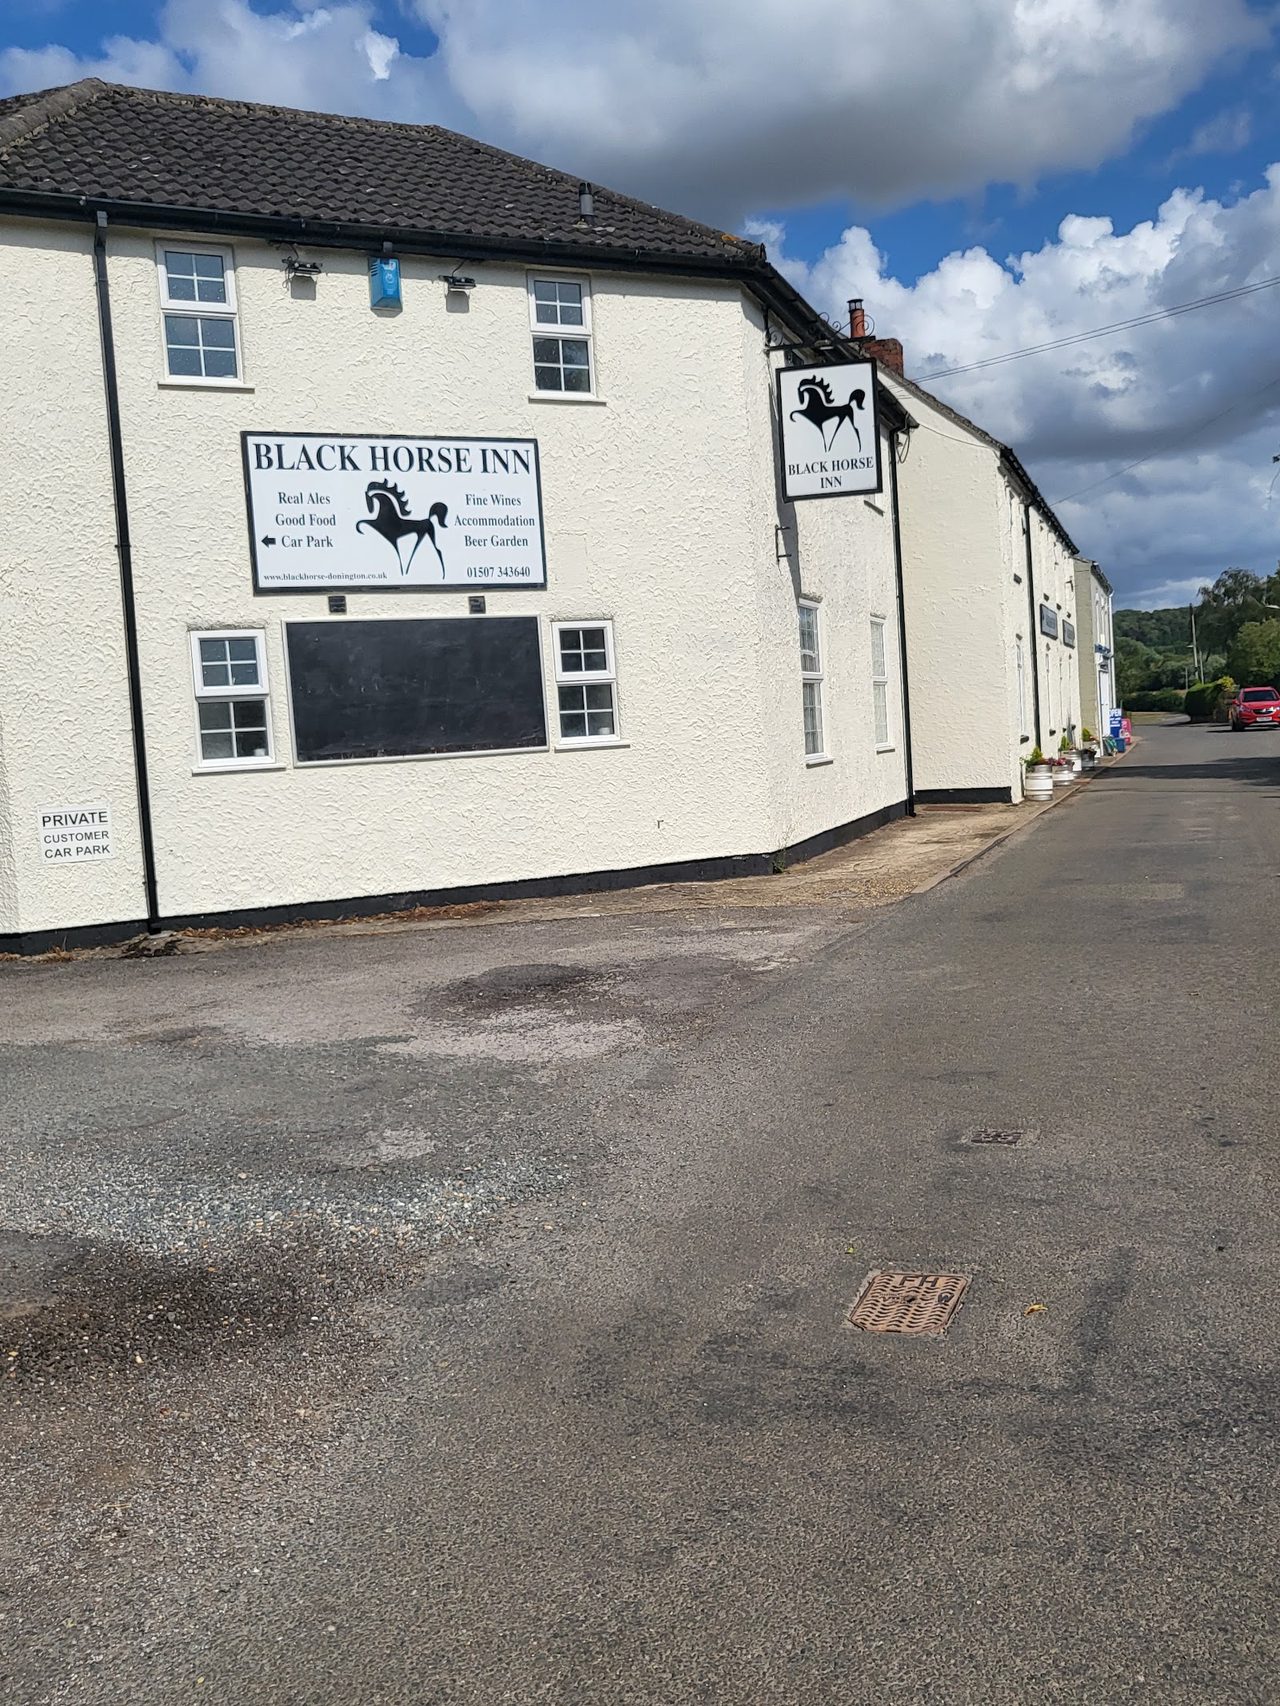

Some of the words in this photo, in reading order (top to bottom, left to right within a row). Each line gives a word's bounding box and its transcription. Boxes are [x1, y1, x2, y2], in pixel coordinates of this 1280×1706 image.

[252, 443, 362, 471] BLACK
[368, 445, 473, 473] HORSE
[480, 448, 530, 474] INN
[788, 460, 829, 476] BLACK
[832, 456, 875, 472] HORSE
[820, 475, 842, 489] INN
[278, 491, 303, 505] Real
[307, 492, 331, 505] Ales
[465, 494, 488, 506] Fine
[490, 494, 522, 506] Wines
[275, 513, 306, 527] Good
[309, 513, 336, 527] Food
[454, 514, 536, 527] Accommodation
[281, 535, 303, 548] Car
[306, 535, 334, 548] Park
[464, 535, 488, 547] Beer
[491, 534, 529, 547] Garden
[263, 572, 388, 582] www.blackhorse-donington.co.uk
[466, 566, 495, 578] 01507
[497, 566, 531, 578] 343640
[42, 811, 109, 827] PRIVATE
[43, 830, 110, 845] CUSTOMER
[44, 847, 72, 859] CAR
[76, 844, 111, 857] PARK
